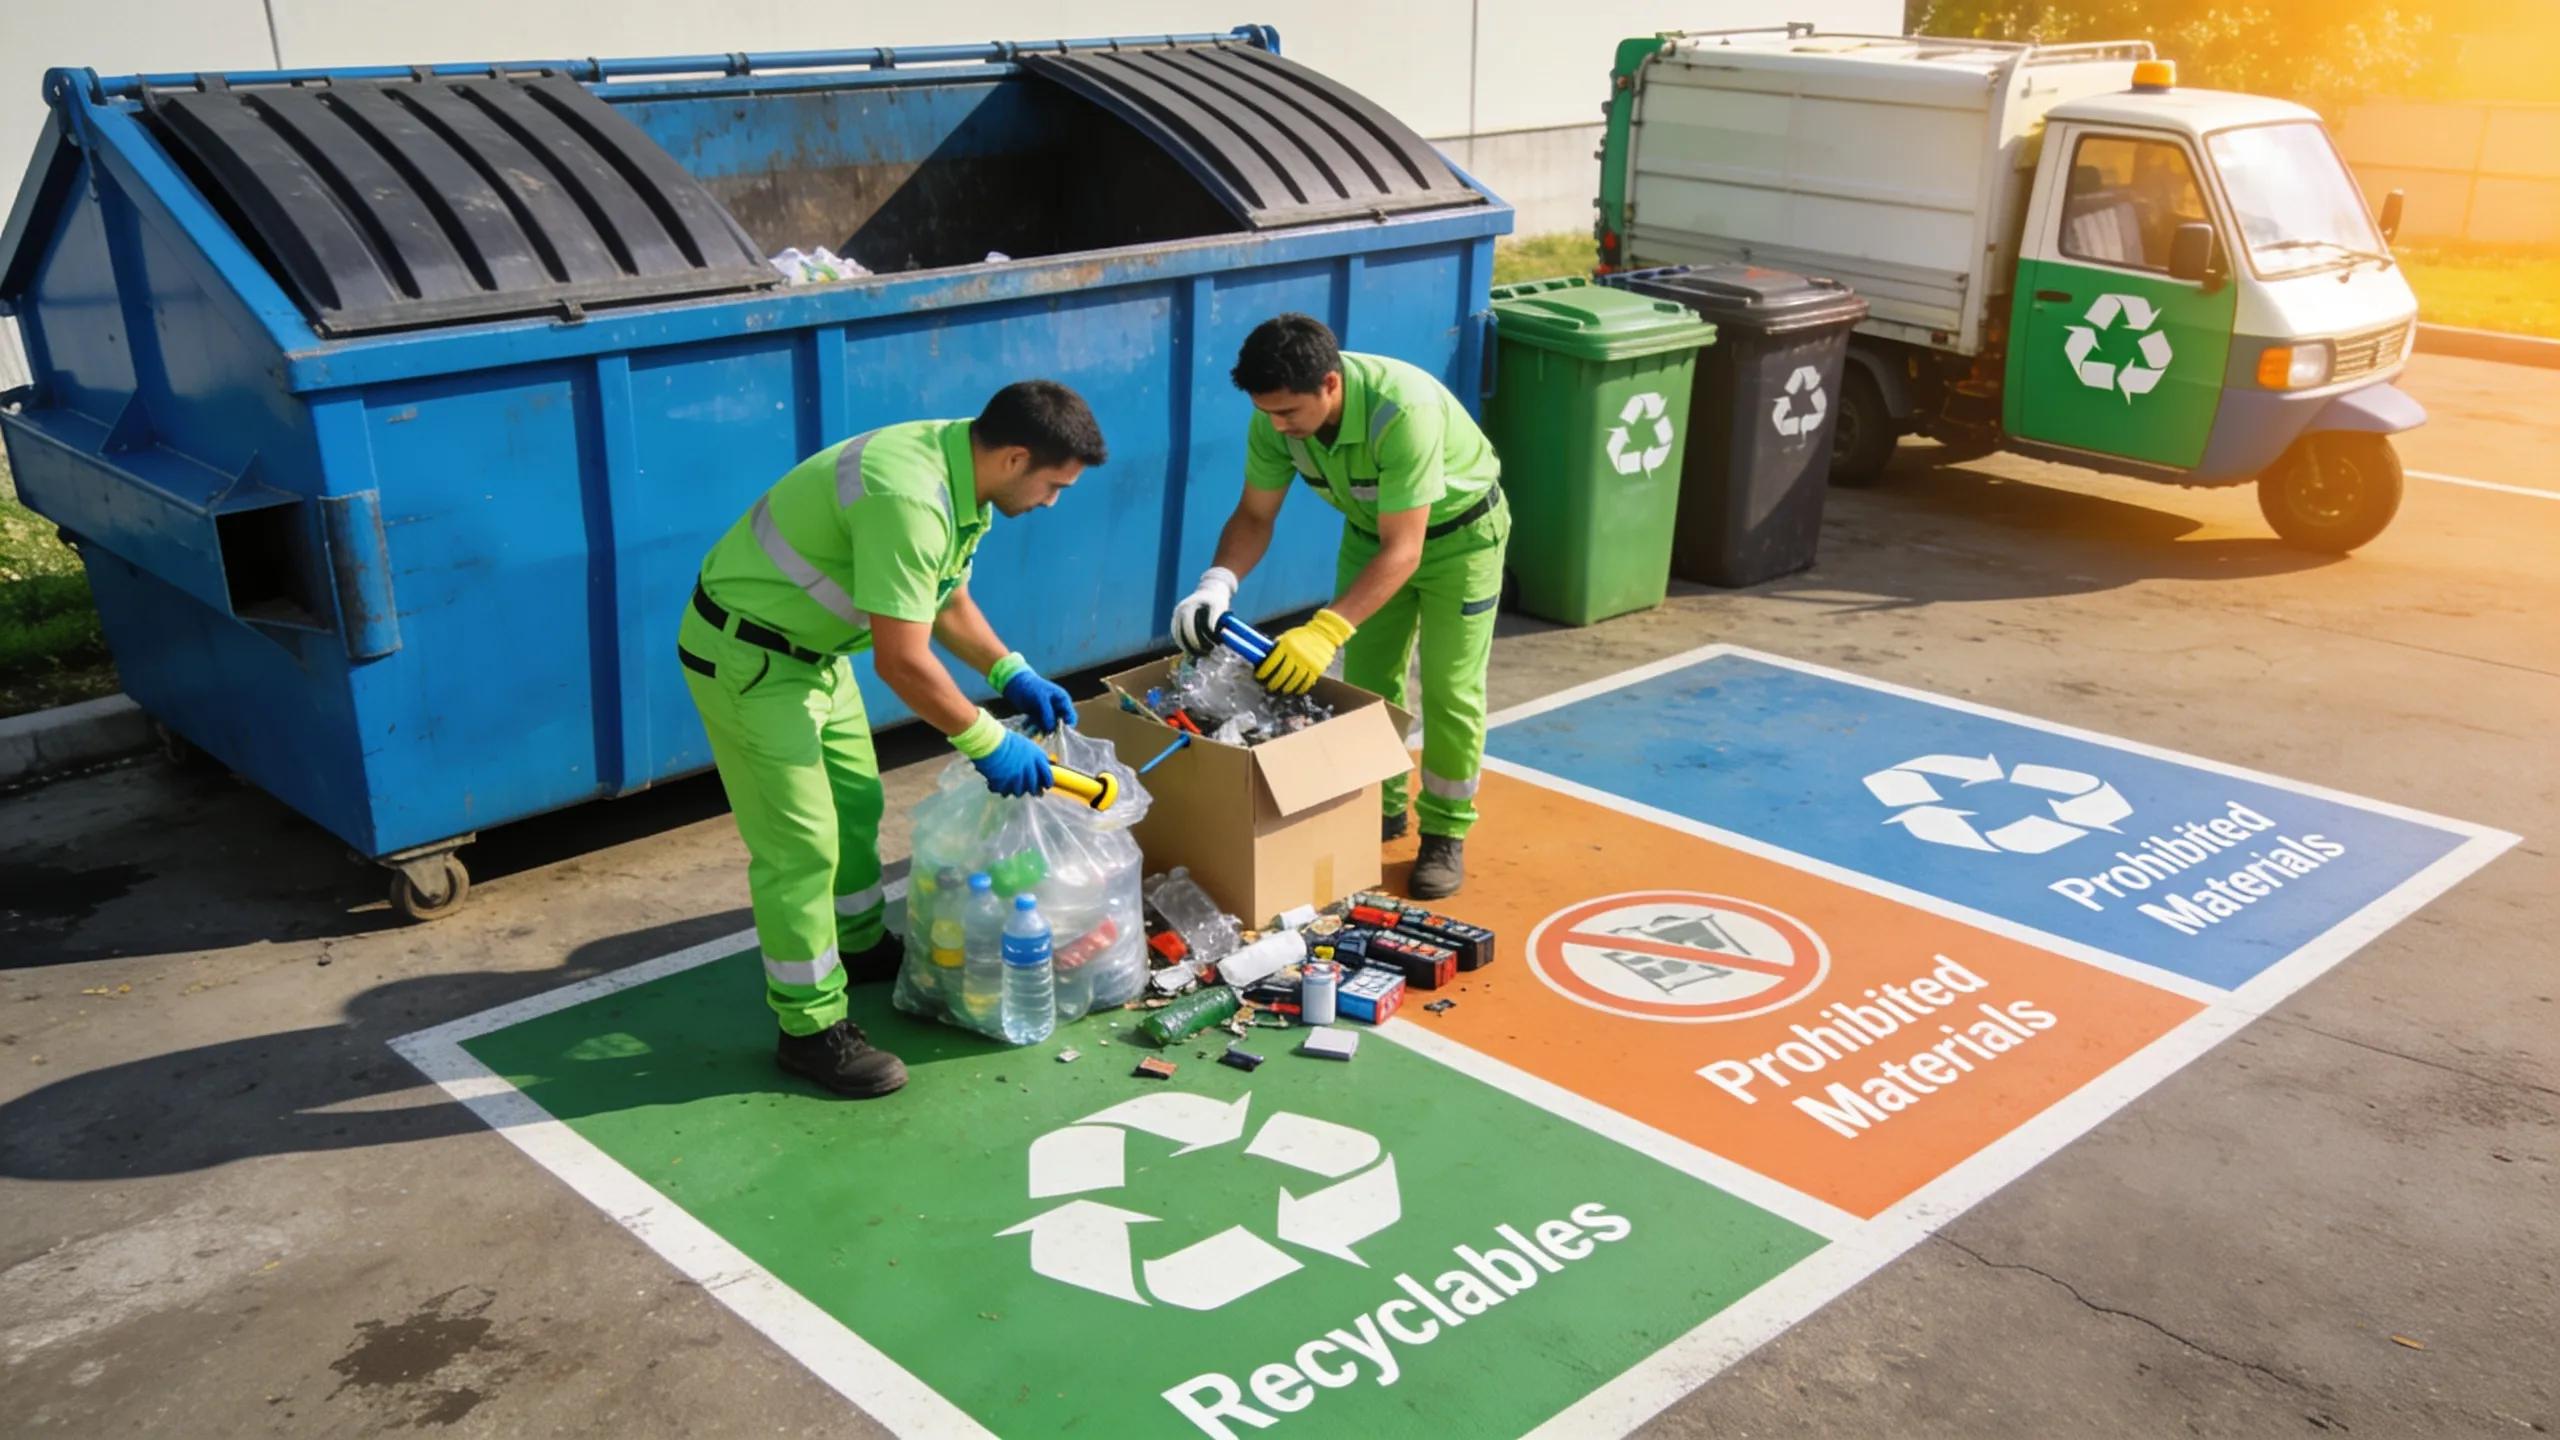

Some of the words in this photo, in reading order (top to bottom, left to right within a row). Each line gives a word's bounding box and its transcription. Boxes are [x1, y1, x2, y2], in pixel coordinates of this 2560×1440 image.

[2048, 801, 2276, 911] Prohibited
[2137, 834, 2345, 935] Materials
[1696, 954, 1988, 1104] Prohibited
[1792, 1000, 2057, 1139] Materials
[1161, 1202, 1631, 1440] Recyclables
